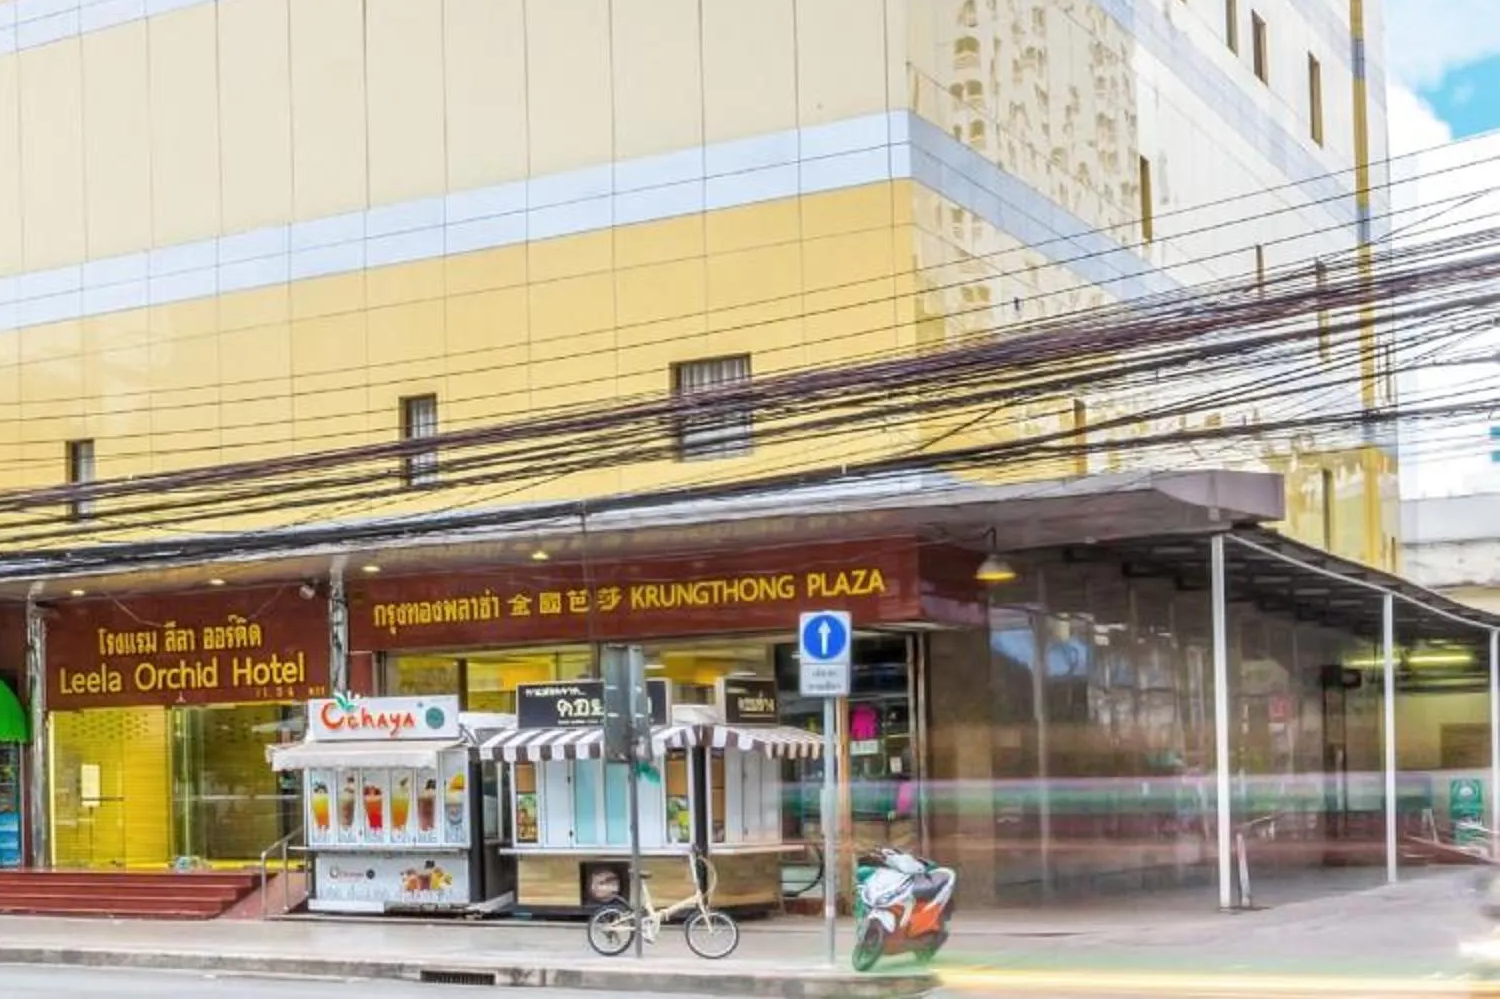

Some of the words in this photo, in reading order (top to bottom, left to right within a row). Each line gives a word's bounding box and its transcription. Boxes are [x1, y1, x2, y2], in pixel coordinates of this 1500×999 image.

[630, 574, 795, 610] KRUNGTHONG
[807, 568, 886, 598] PLAZA
[60, 663, 122, 694] Leela
[135, 657, 218, 691] Orchid
[232, 651, 305, 686] Hotel
